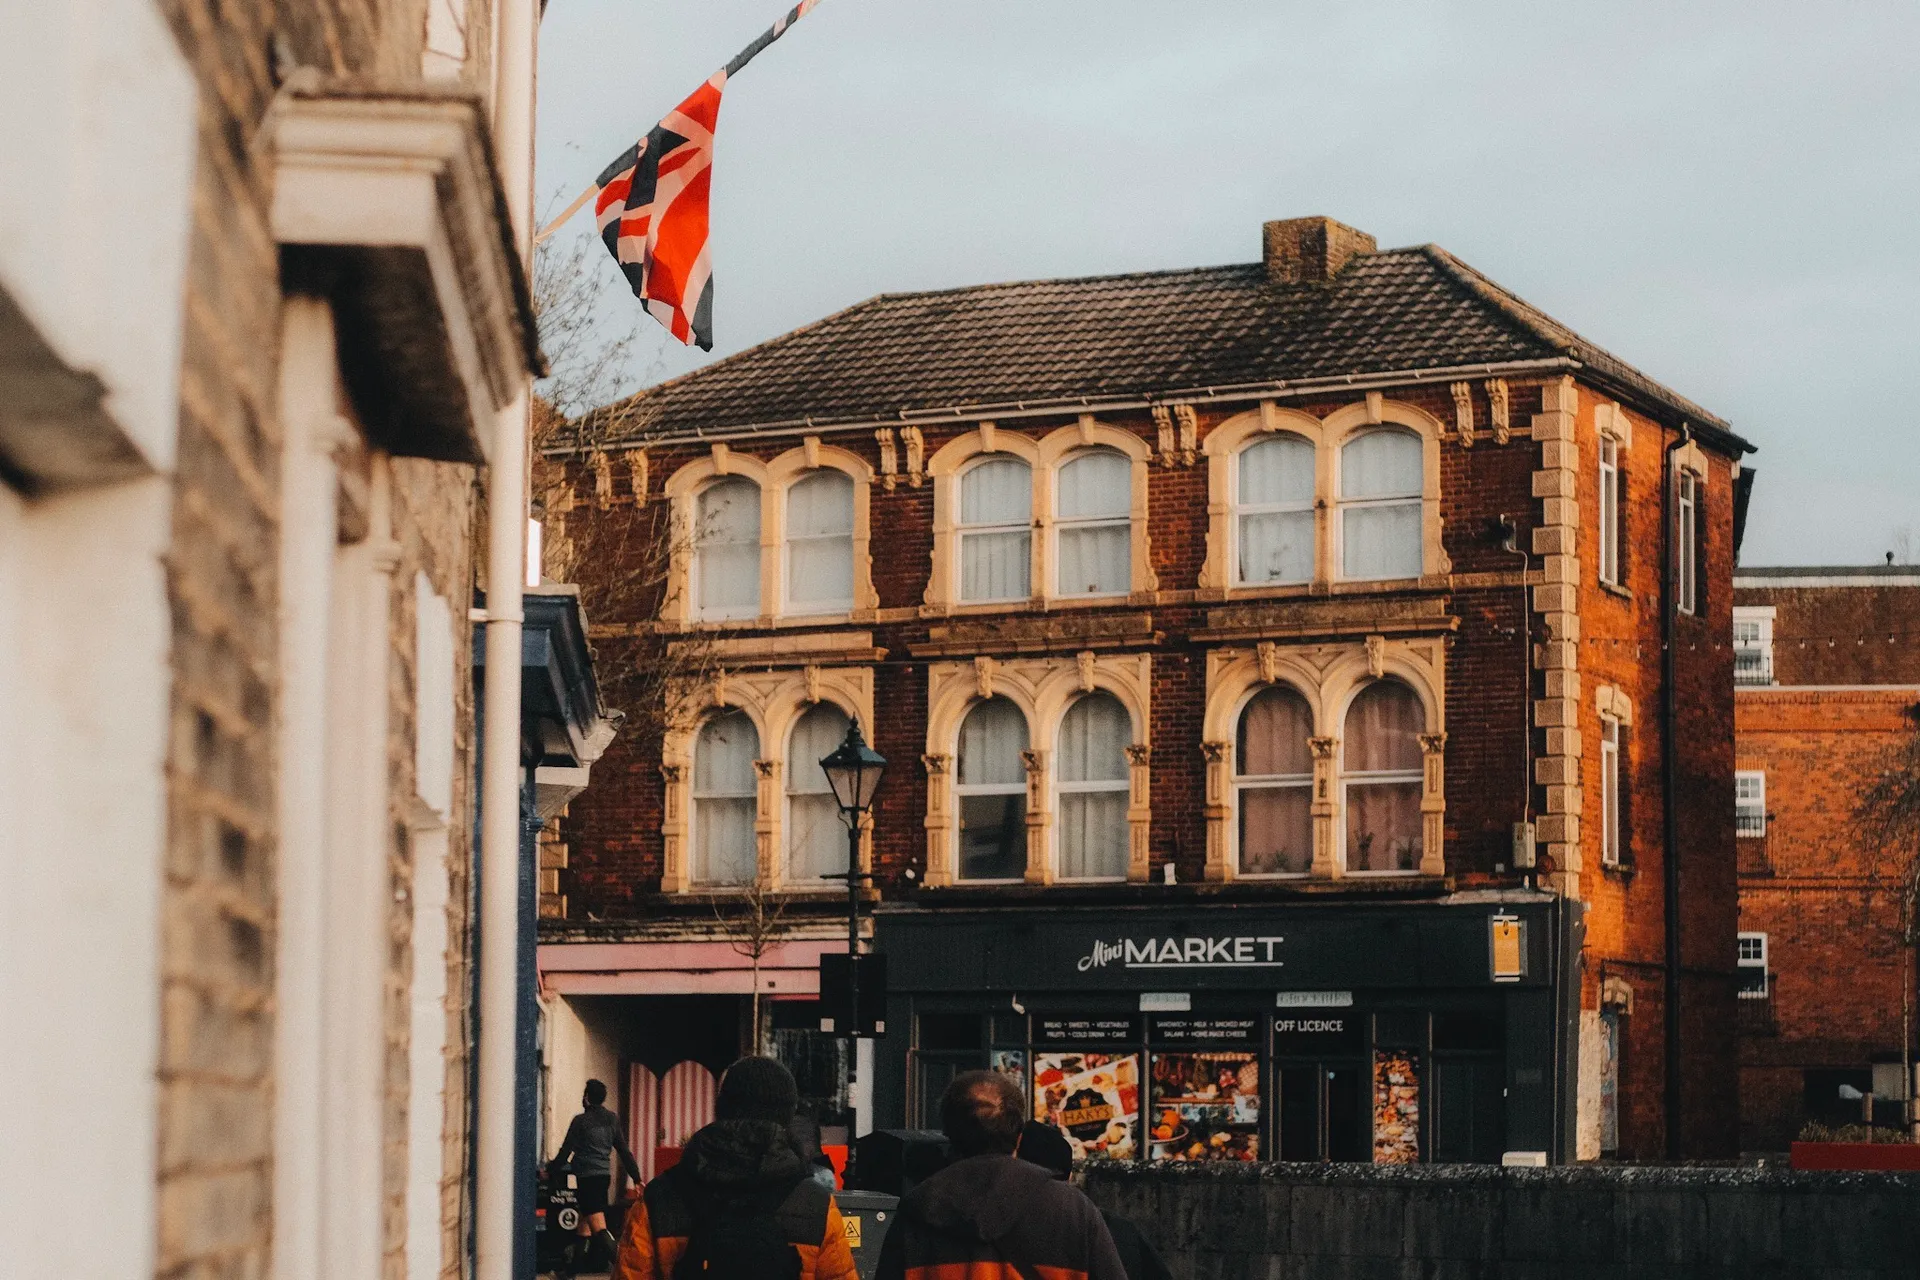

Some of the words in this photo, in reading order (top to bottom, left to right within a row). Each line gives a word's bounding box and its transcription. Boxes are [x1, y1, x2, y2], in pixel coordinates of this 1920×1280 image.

[1077, 939, 1122, 972] Mini
[1124, 937, 1284, 963] MARKET
[1275, 1020, 1295, 1032] OFF
[1297, 1020, 1344, 1032] LICENCE
